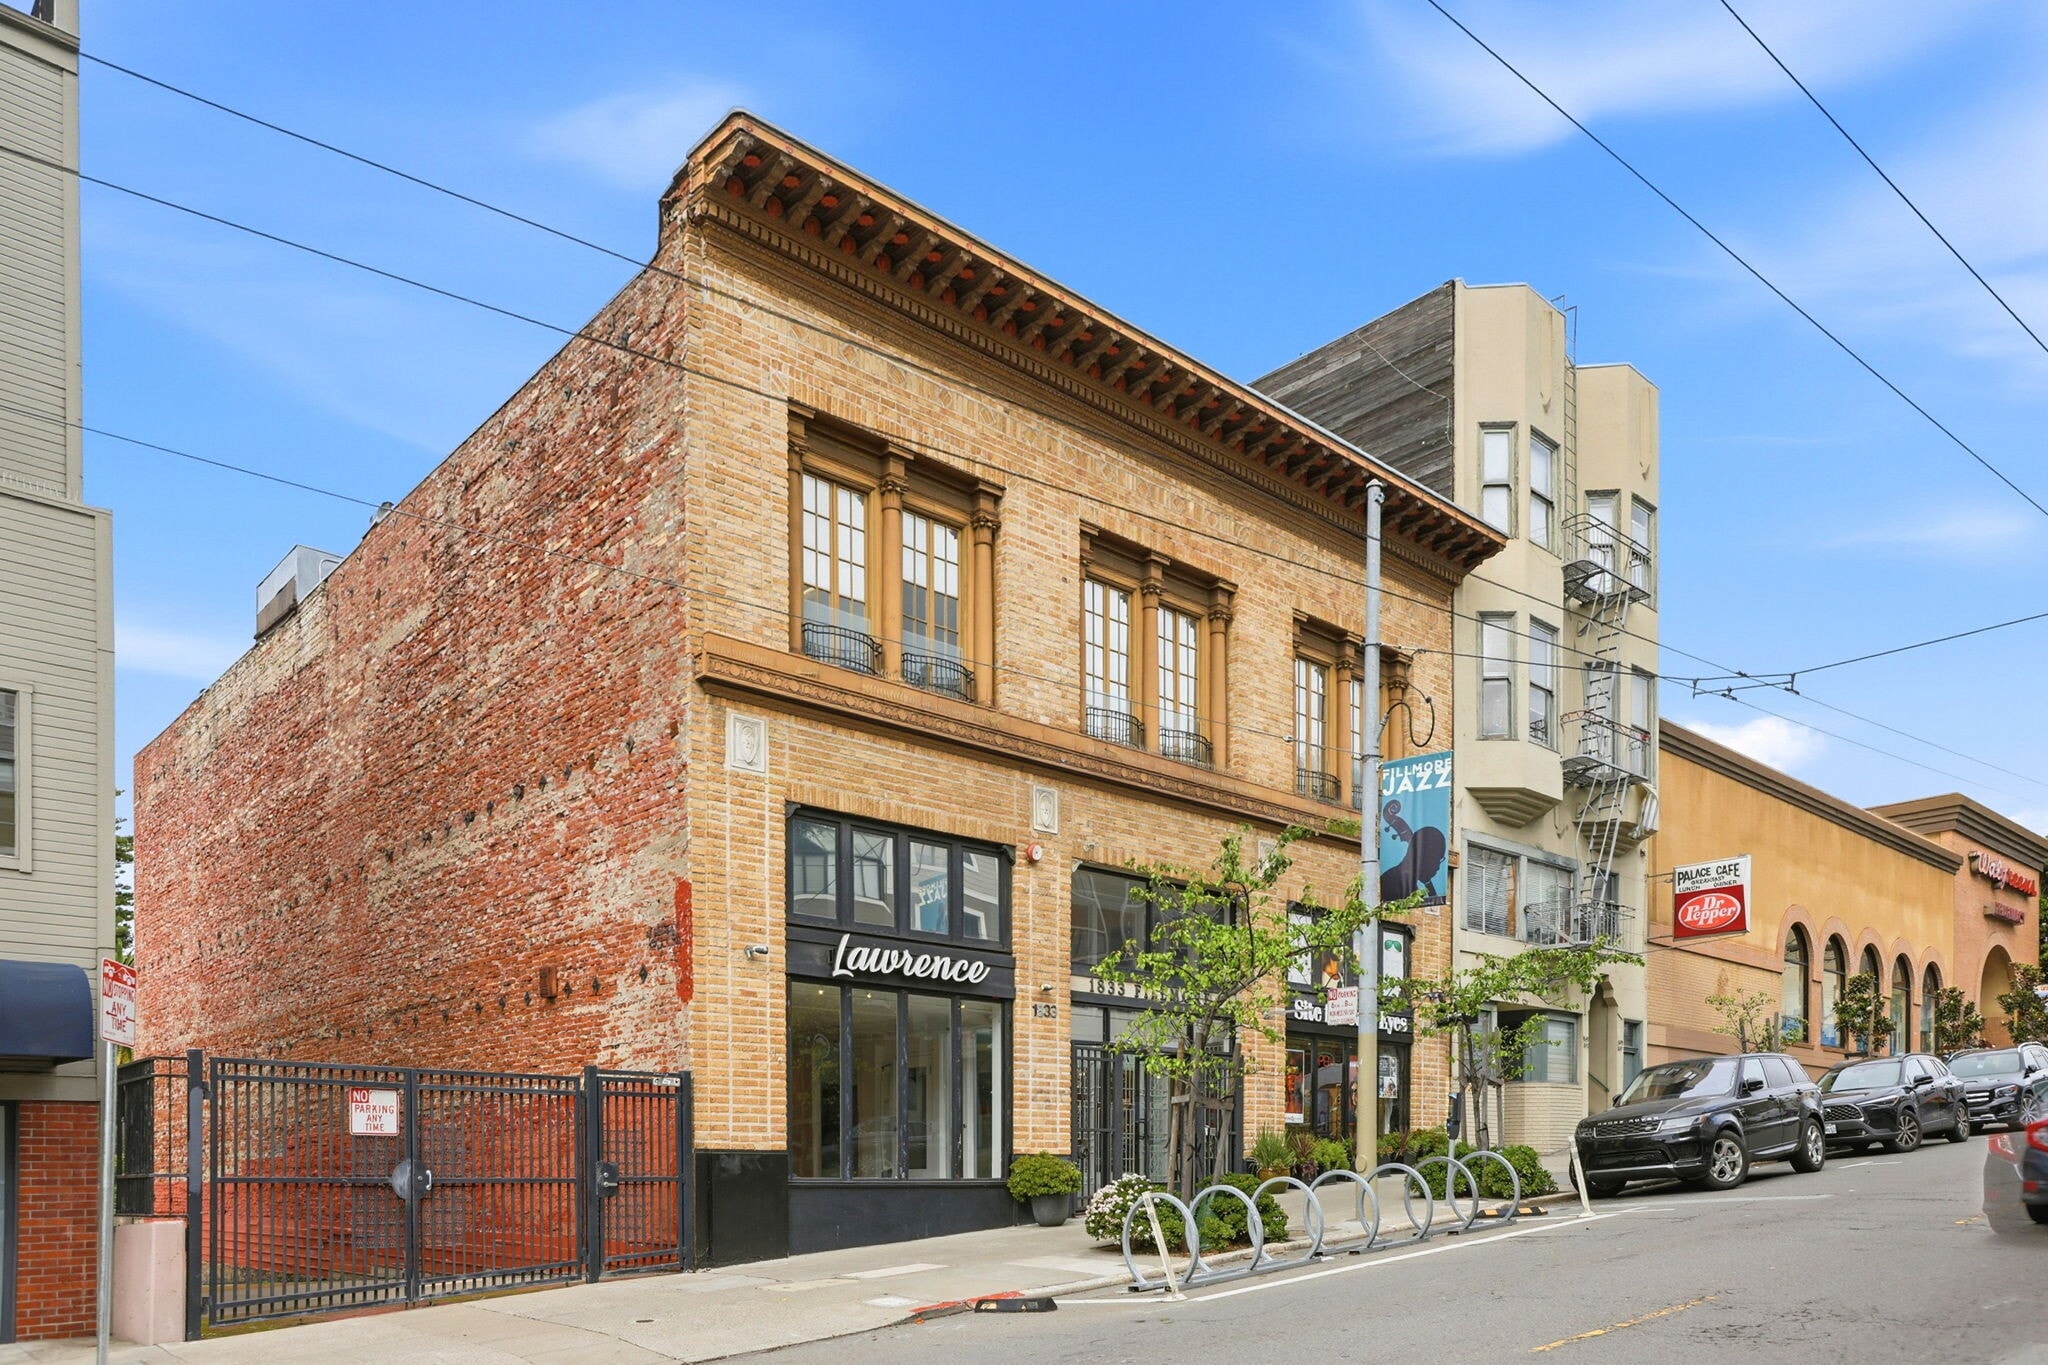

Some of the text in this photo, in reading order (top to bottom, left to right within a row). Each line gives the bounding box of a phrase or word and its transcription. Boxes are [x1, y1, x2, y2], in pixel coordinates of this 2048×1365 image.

[1383, 758, 1452, 780] FILLMORE
[1383, 767, 1452, 796] JAZZ
[1677, 863, 1740, 886] PALACE CAFE
[1974, 851, 2037, 897] Walgreens
[1701, 896, 1725, 911] Dr
[1684, 905, 1737, 926] Pepper
[832, 933, 990, 984] Lawrence
[113, 984, 134, 1003] STOPPING
[1089, 978, 1125, 996] 1833
[112, 1001, 127, 1016] ANY
[1032, 1003, 1057, 1018] 1833
[1294, 999, 1322, 1022] Site
[1379, 1011, 1408, 1035] Eyes
[112, 1017, 127, 1033] TIME
[353, 1090, 368, 1102] NO
[354, 1104, 395, 1114] PARKING
[366, 1114, 383, 1122] ANY
[365, 1123, 385, 1132] TIME
